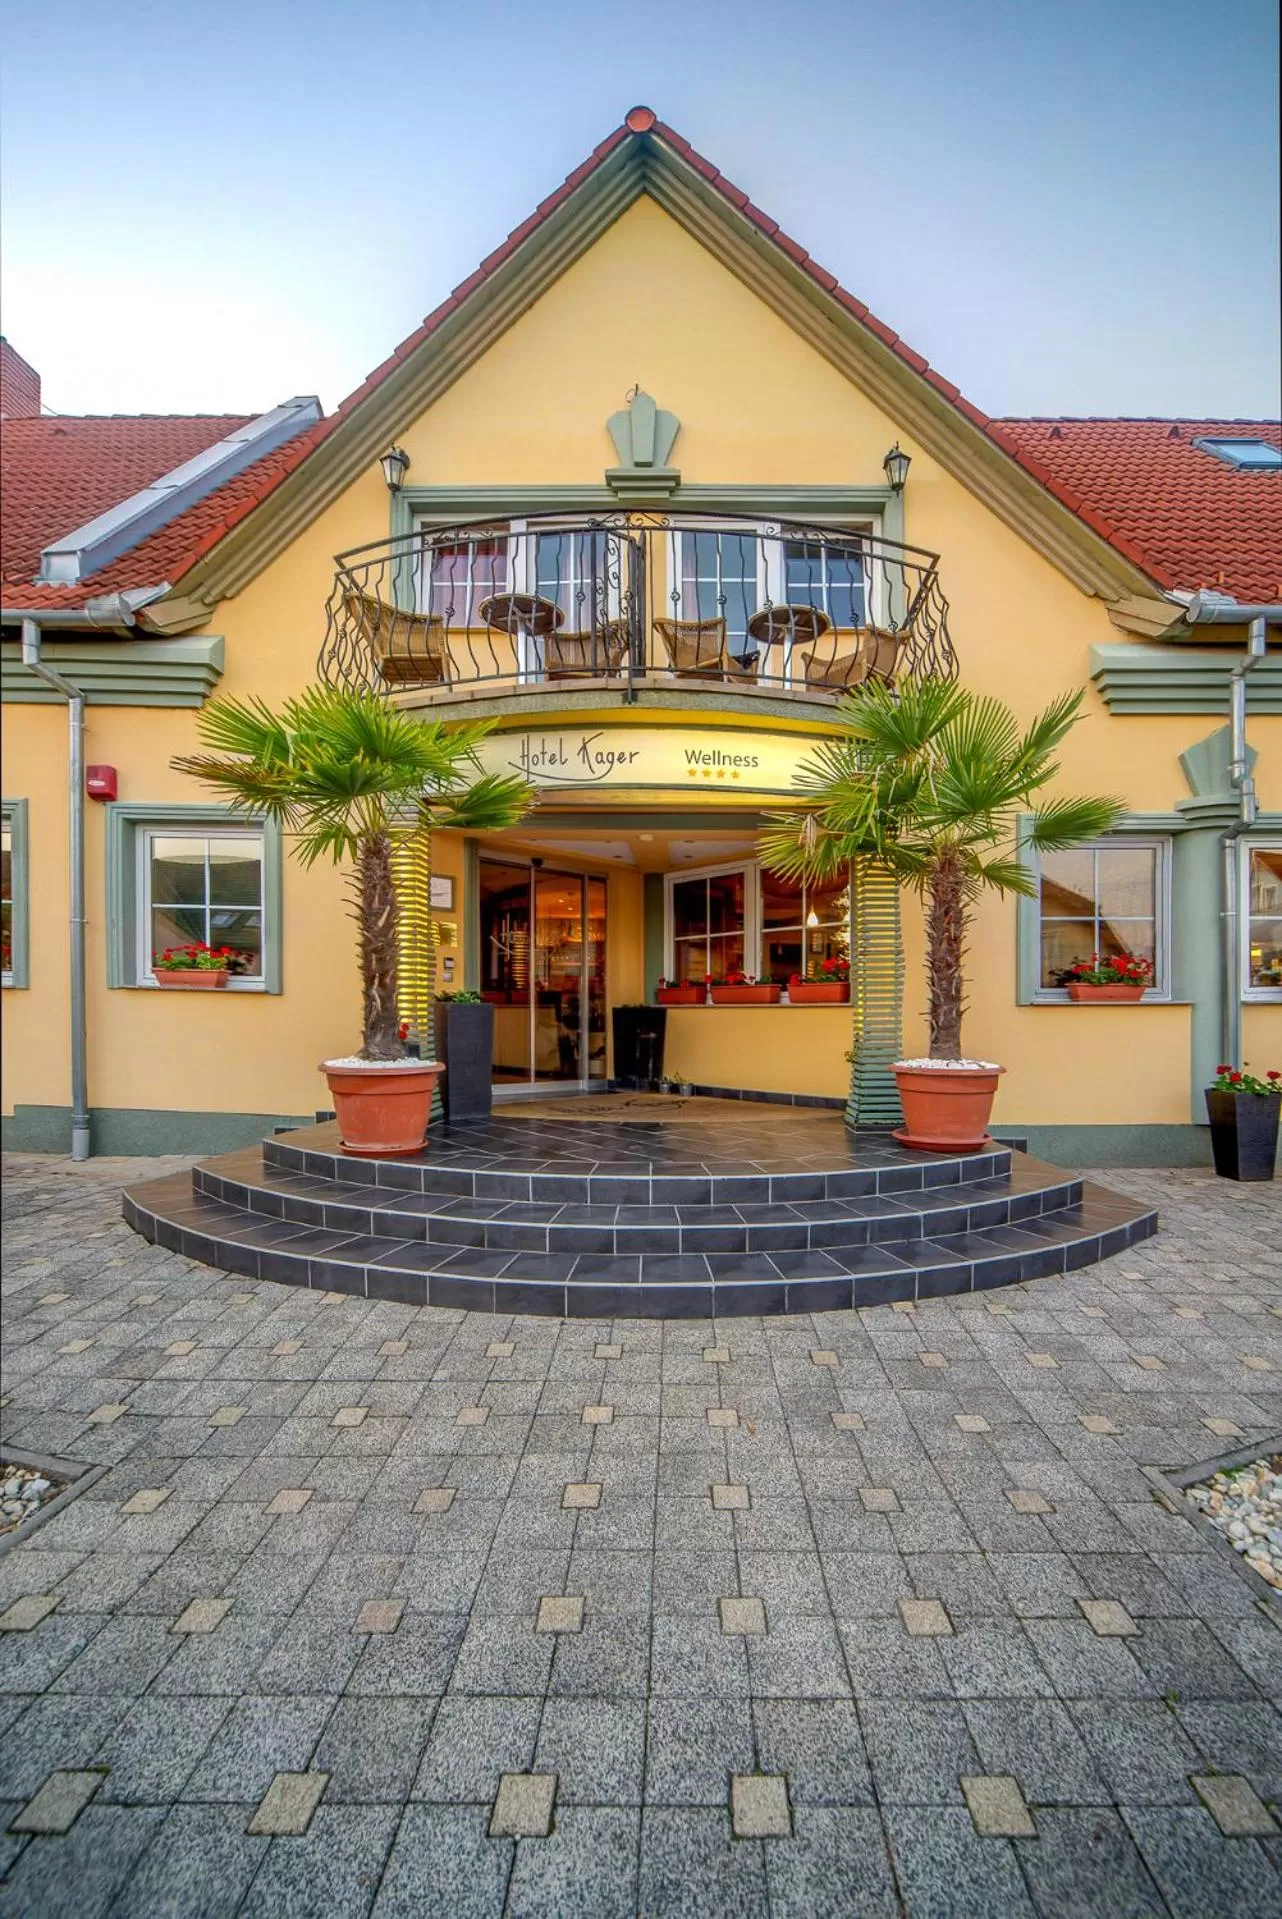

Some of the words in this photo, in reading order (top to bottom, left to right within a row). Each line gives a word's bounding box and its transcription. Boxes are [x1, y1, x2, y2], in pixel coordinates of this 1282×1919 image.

[519, 734, 569, 780] Hotel
[577, 731, 640, 780] Kager
[684, 748, 759, 768] Wellness
